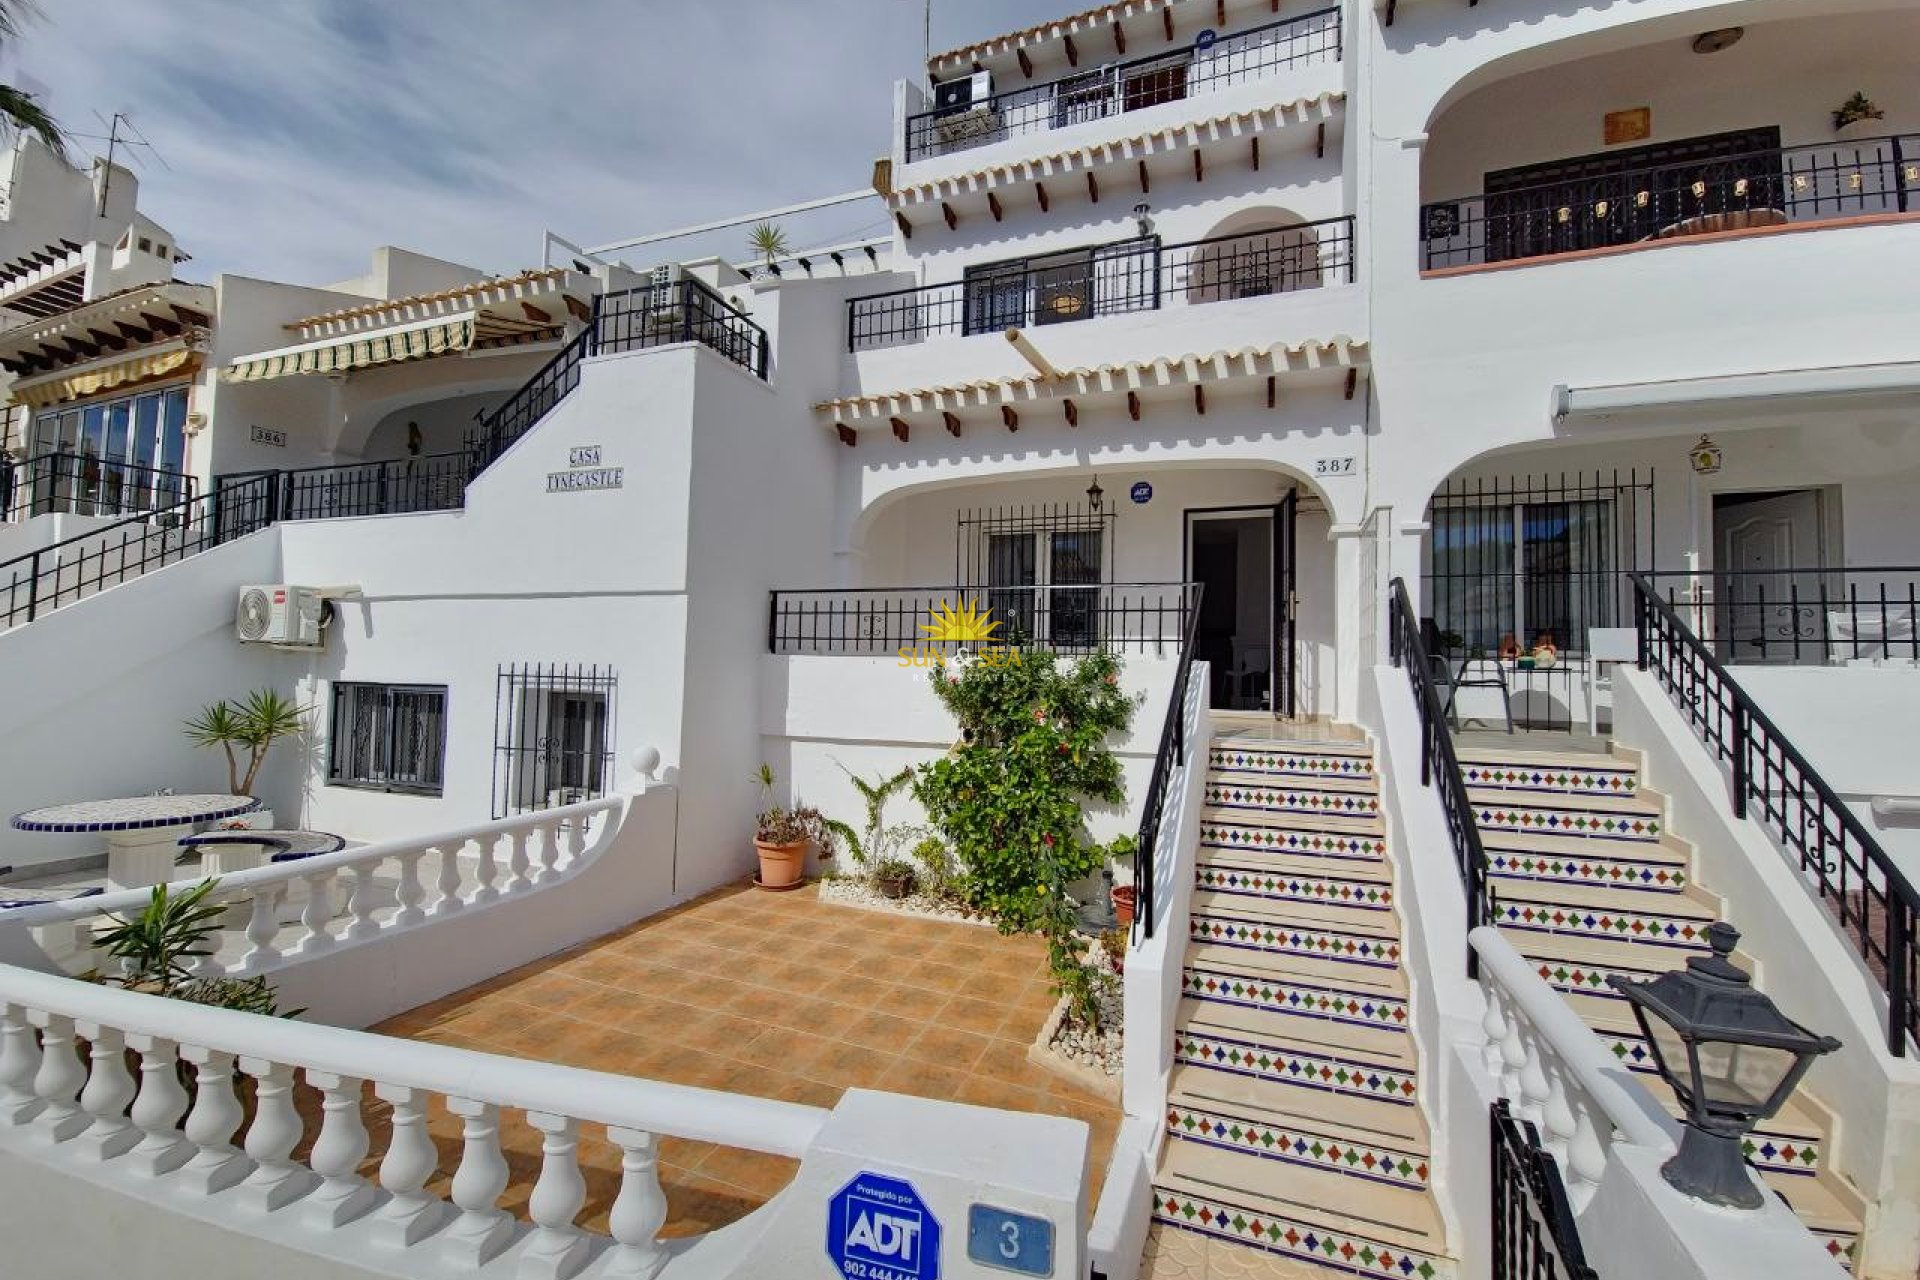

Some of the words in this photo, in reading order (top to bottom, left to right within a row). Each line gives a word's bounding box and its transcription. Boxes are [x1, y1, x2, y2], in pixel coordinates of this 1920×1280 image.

[569, 448, 600, 464] CASA
[1317, 458, 1354, 472] 387
[547, 469, 623, 489] TYNECASTLE
[855, 1183, 897, 1200] Protegido
[898, 1194, 913, 1204] por
[848, 1209, 920, 1260] ADT
[999, 1221, 1020, 1258] 3
[844, 1260, 866, 1277] 902
[869, 1267, 892, 1280] 444
